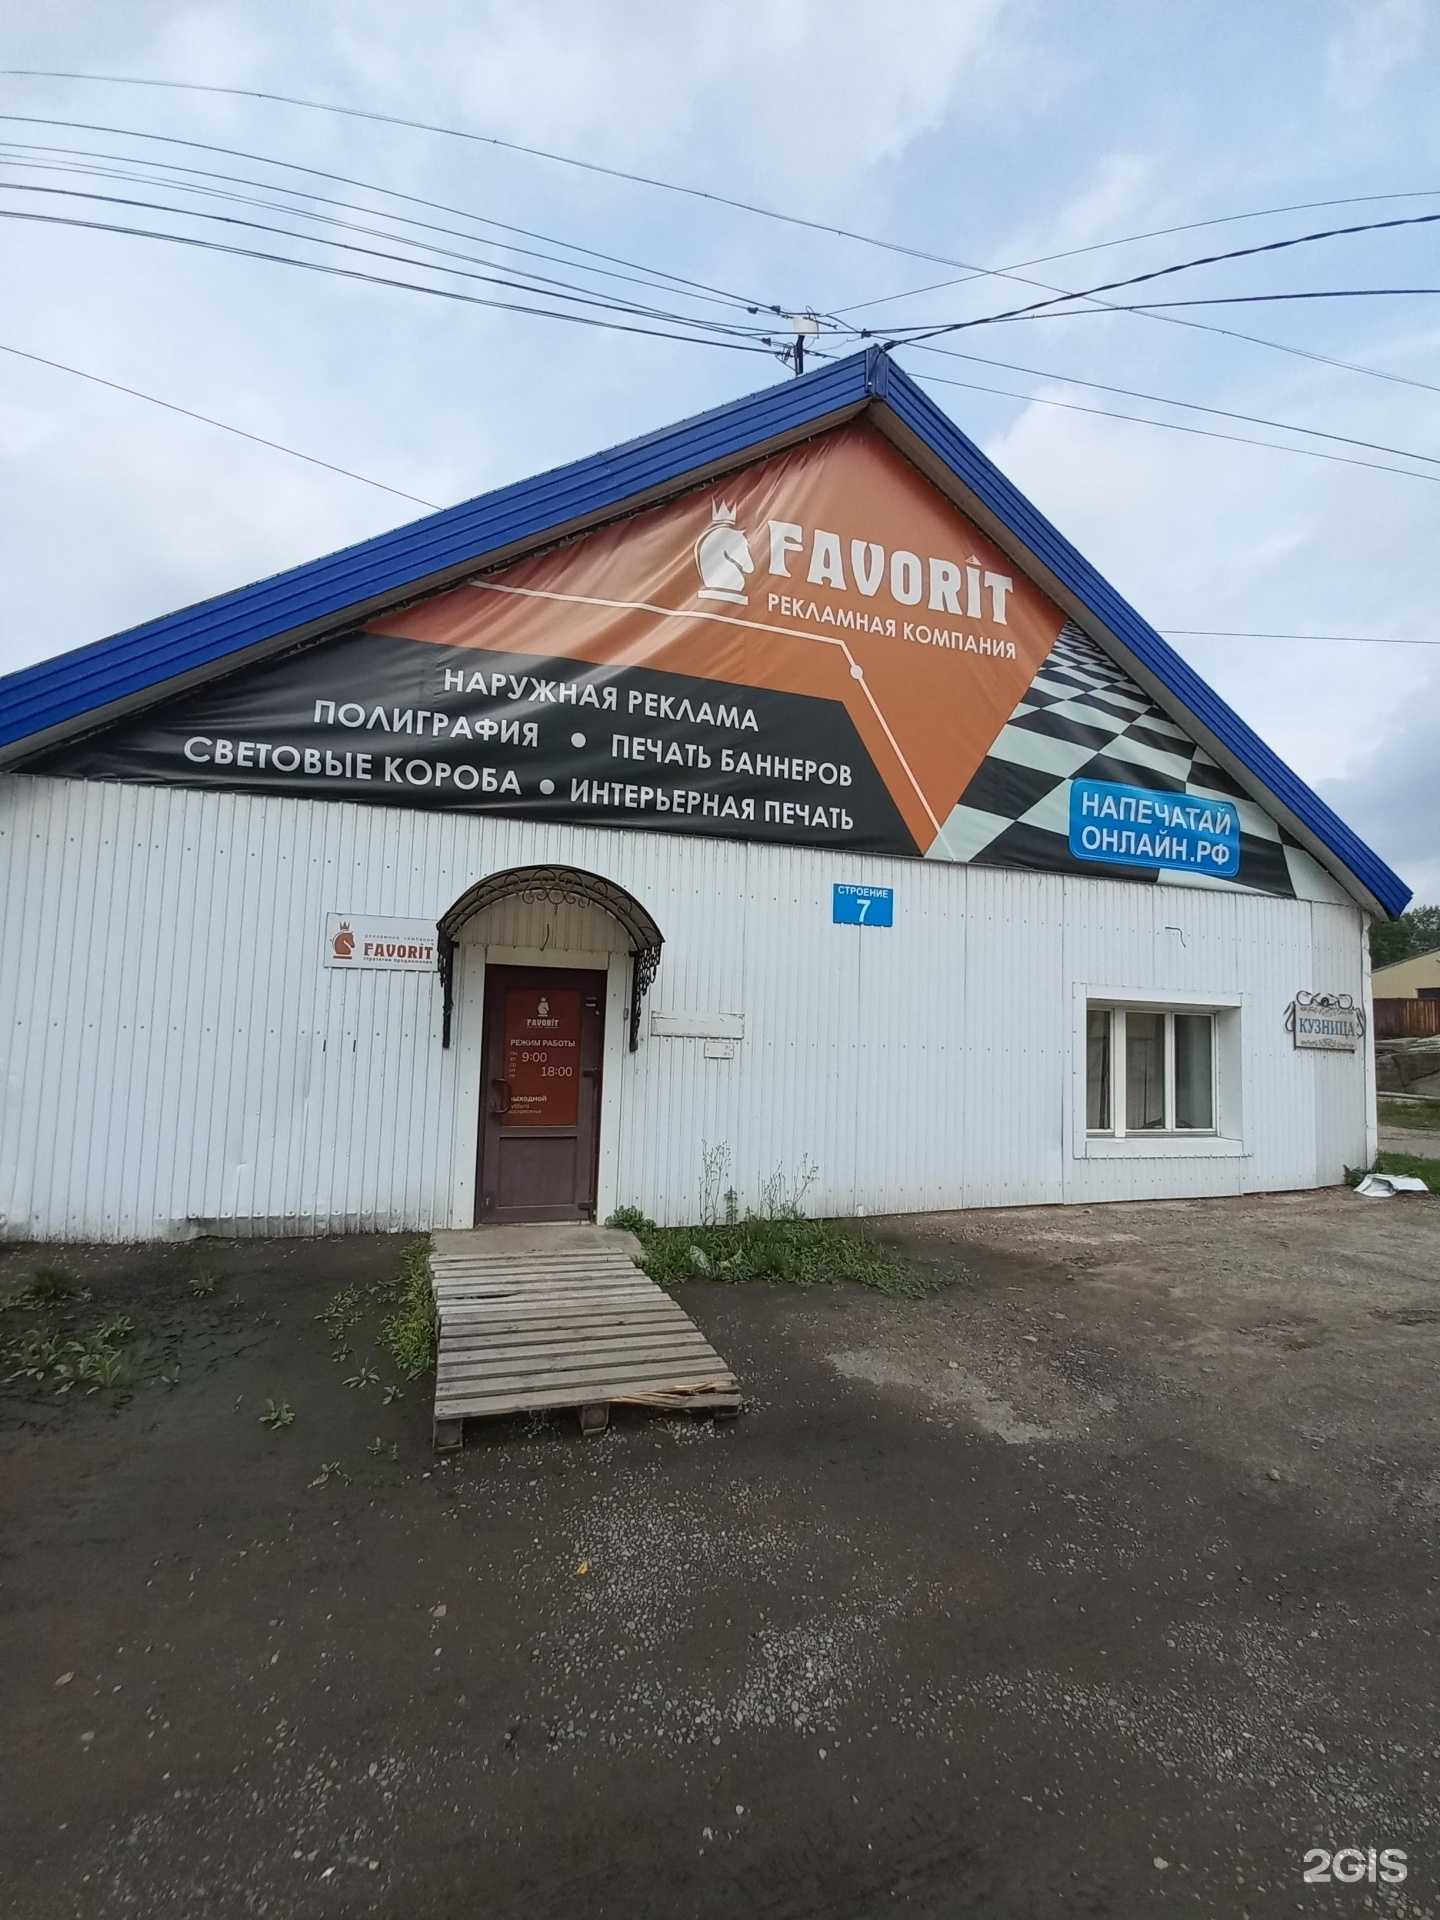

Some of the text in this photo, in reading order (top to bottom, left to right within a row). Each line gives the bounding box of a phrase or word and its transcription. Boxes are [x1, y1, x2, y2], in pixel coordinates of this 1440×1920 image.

[768, 593, 1017, 659] РЕКЛАМНАЯ КОМПАНИЯ
[444, 669, 759, 732] НАРУЖНАЯ РЕКЛАМА
[313, 700, 852, 786] ПОЛИГРАФИЯ ПЕЧАТЬ БАННЕРОВ
[184, 736, 853, 830] СВЕТОВЫЕ КОРОБА ИНТЕРЬЕРНАЯ ПЕЧАТЬ
[1082, 791, 1231, 835] НАПЕЧАТАЙ
[1082, 826, 1229, 865] ОНЛАЙН.РФ
[838, 886, 889, 898] СТРОЕНИЕ
[857, 899, 871, 923] 7
[522, 1052, 547, 1062] 9:00
[541, 1066, 573, 1077] 18:00
